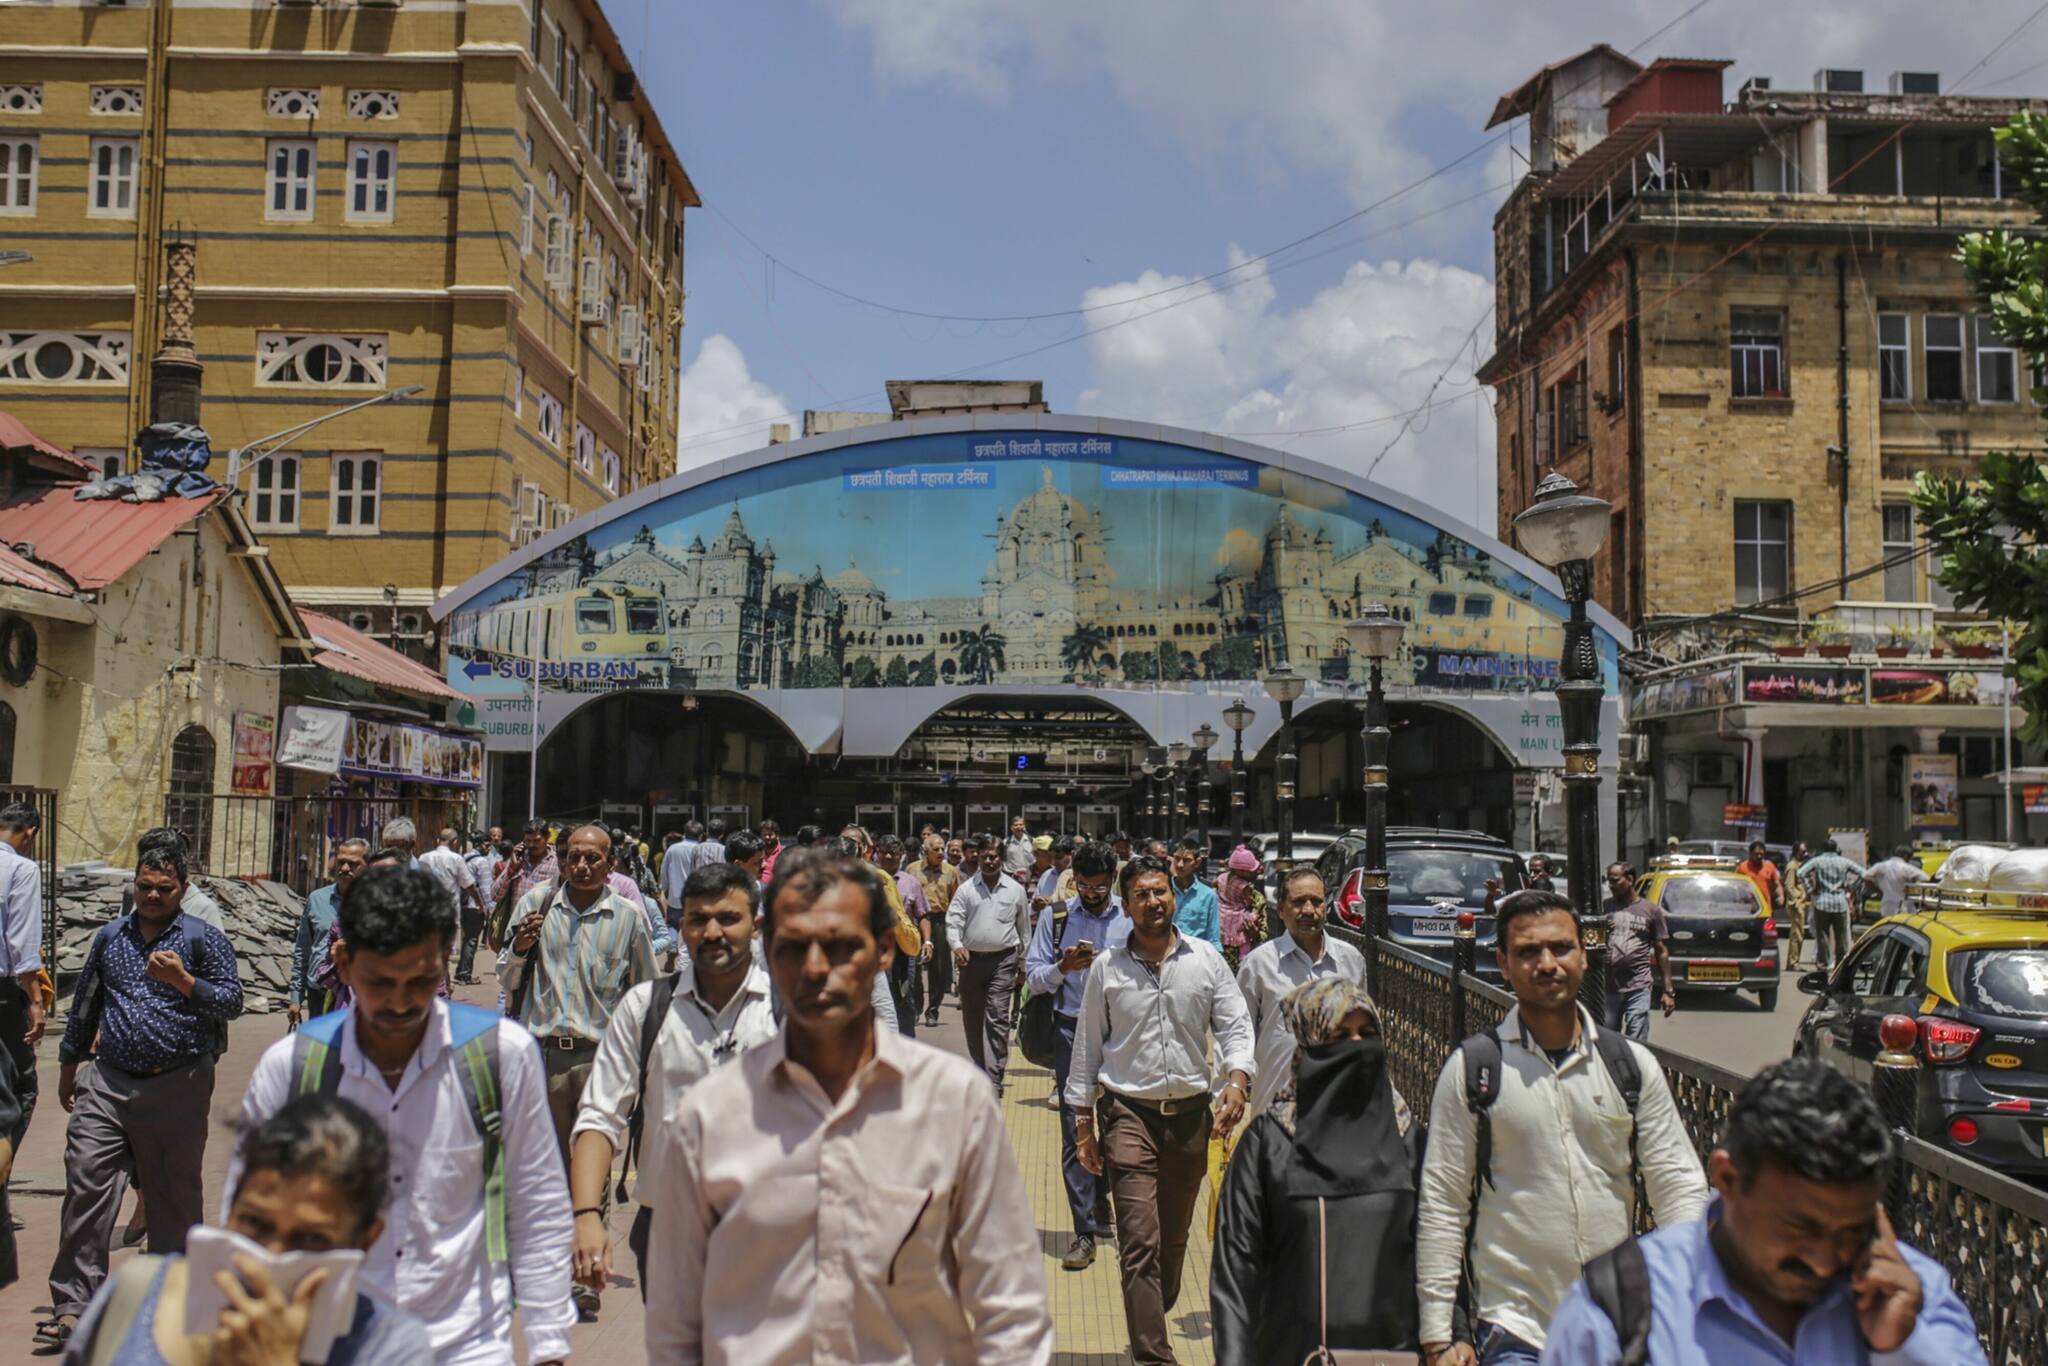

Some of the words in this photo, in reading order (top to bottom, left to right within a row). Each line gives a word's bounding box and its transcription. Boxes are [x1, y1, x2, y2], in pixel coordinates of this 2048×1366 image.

[975, 440, 1006, 457] छत्रपति
[1009, 438, 1041, 456] शिवाजी
[1045, 441, 1078, 457] महाराज
[1080, 438, 1112, 455] टर्मिनस
[885, 469, 917, 486] शिवाजी
[921, 471, 954, 487] महाराज
[957, 468, 988, 485] टर्मिनस
[500, 661, 637, 679] SUBURBAN
[1438, 655, 1559, 677] MAINLINE
[1520, 710, 1540, 728] मेन
[1520, 738, 1548, 750] MAIN
[1414, 921, 1437, 931] MH03
[1439, 922, 1451, 932] DA
